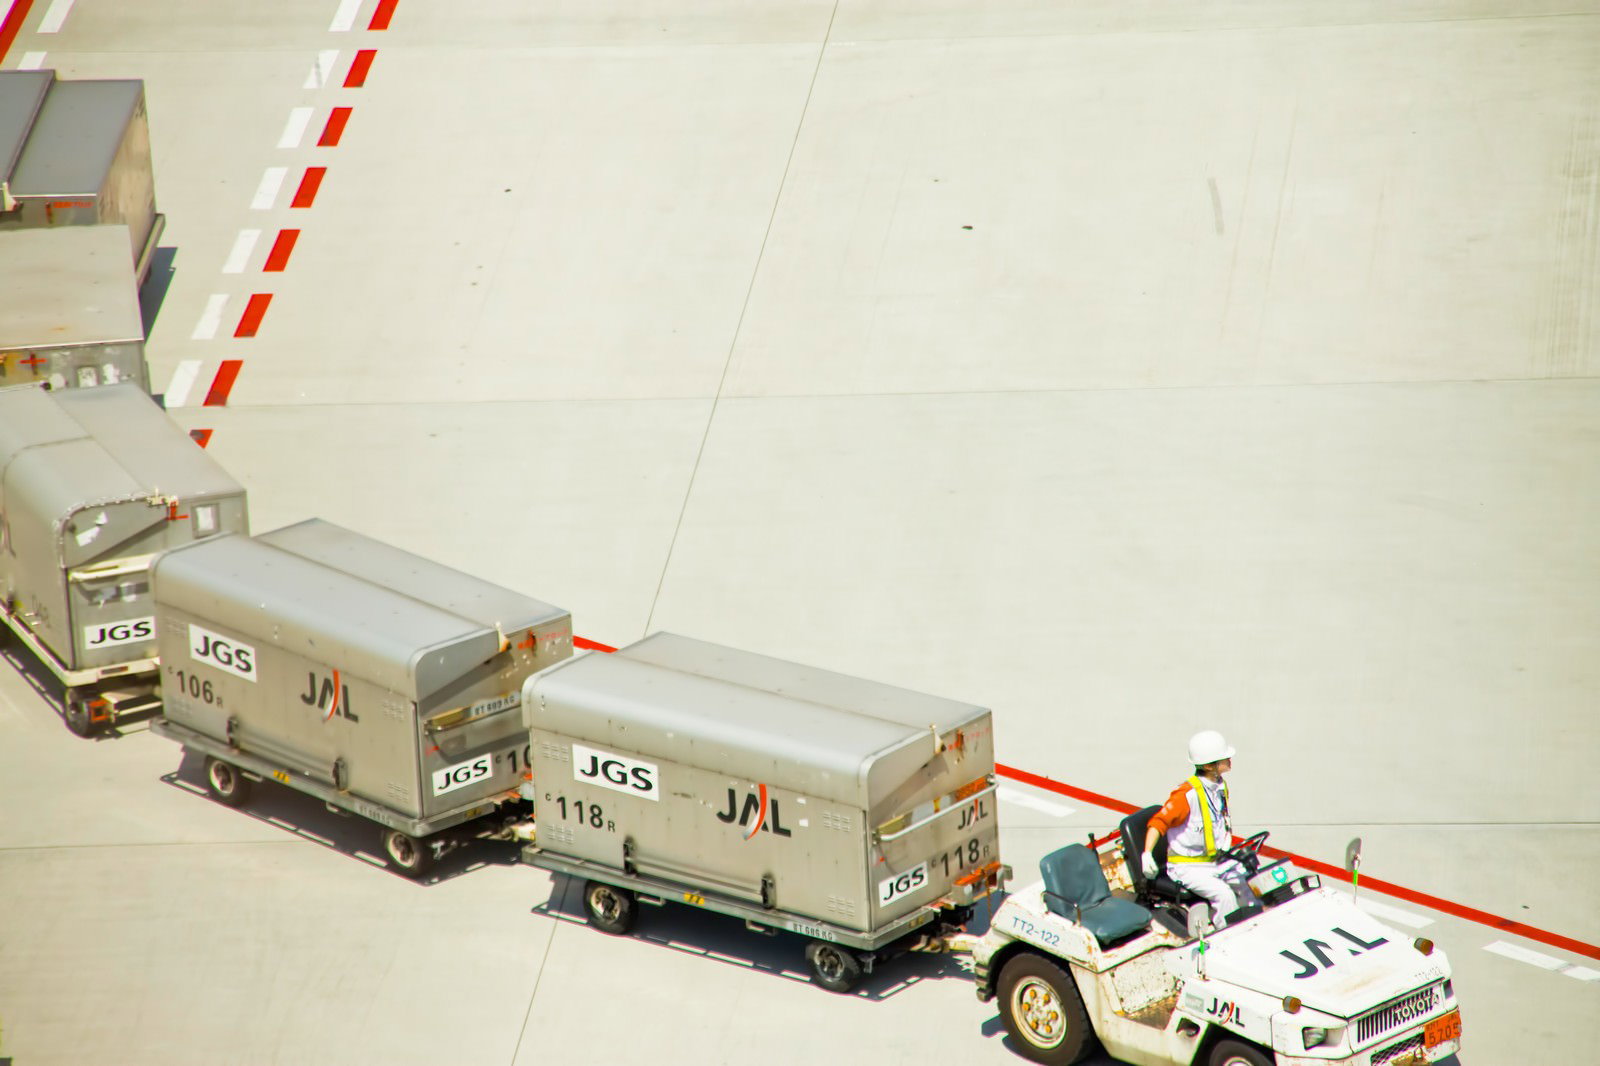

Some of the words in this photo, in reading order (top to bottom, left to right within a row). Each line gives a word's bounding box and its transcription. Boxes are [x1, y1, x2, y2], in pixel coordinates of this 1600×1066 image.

[90, 621, 151, 644] JGS
[195, 636, 252, 672] JGS
[177, 670, 213, 704] 106
[301, 669, 359, 724] JAL
[438, 760, 488, 789] JGS
[580, 756, 653, 791] JGS
[557, 797, 603, 829] 118
[607, 821, 615, 832] R
[716, 784, 792, 839] JAL
[958, 798, 988, 830] JAL
[941, 839, 979, 877] 118
[884, 867, 924, 900] JGS
[1013, 916, 1060, 947] TT2-122
[1279, 927, 1390, 979] JAL
[1207, 997, 1246, 1027] JAL
[1393, 994, 1440, 1021] TOYOTA
